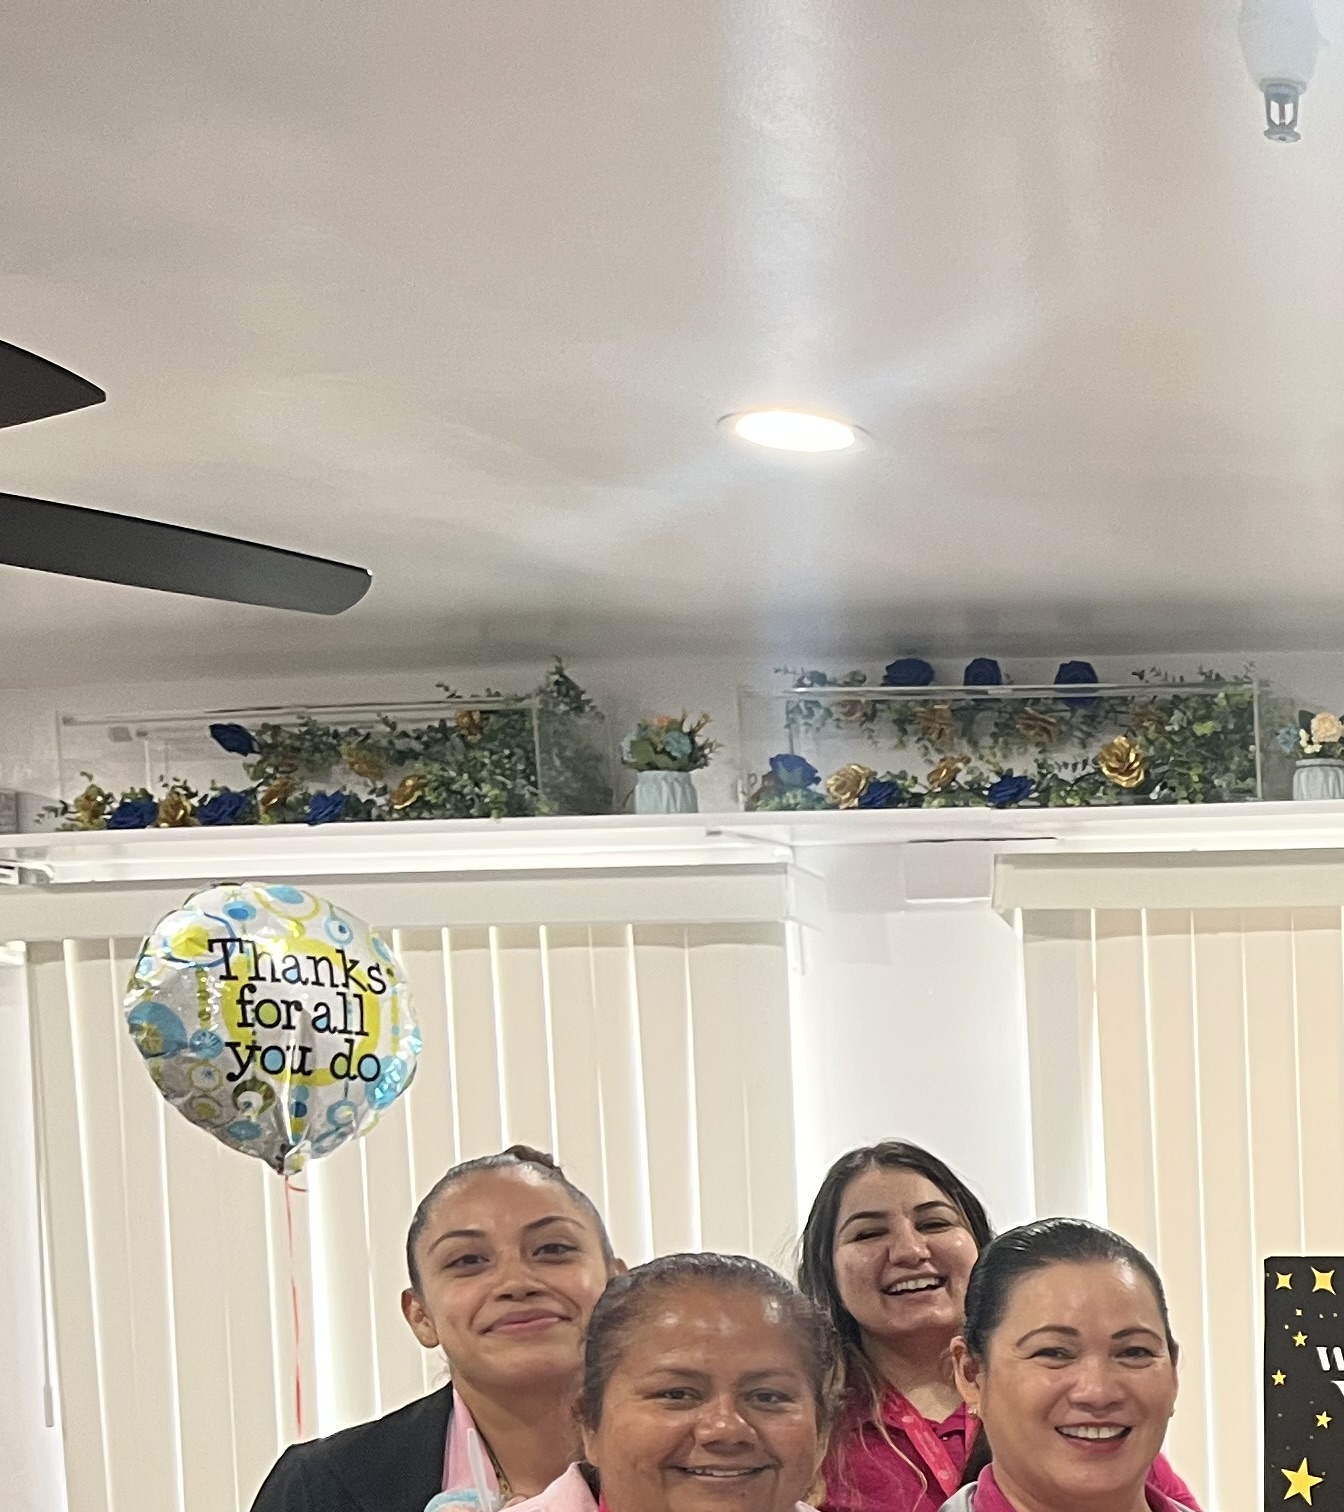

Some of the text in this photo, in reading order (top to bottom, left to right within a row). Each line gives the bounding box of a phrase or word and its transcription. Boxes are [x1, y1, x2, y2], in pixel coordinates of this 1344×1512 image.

[208, 938, 386, 994] Thanks
[236, 984, 369, 1036] for all
[225, 1039, 381, 1082] you do
